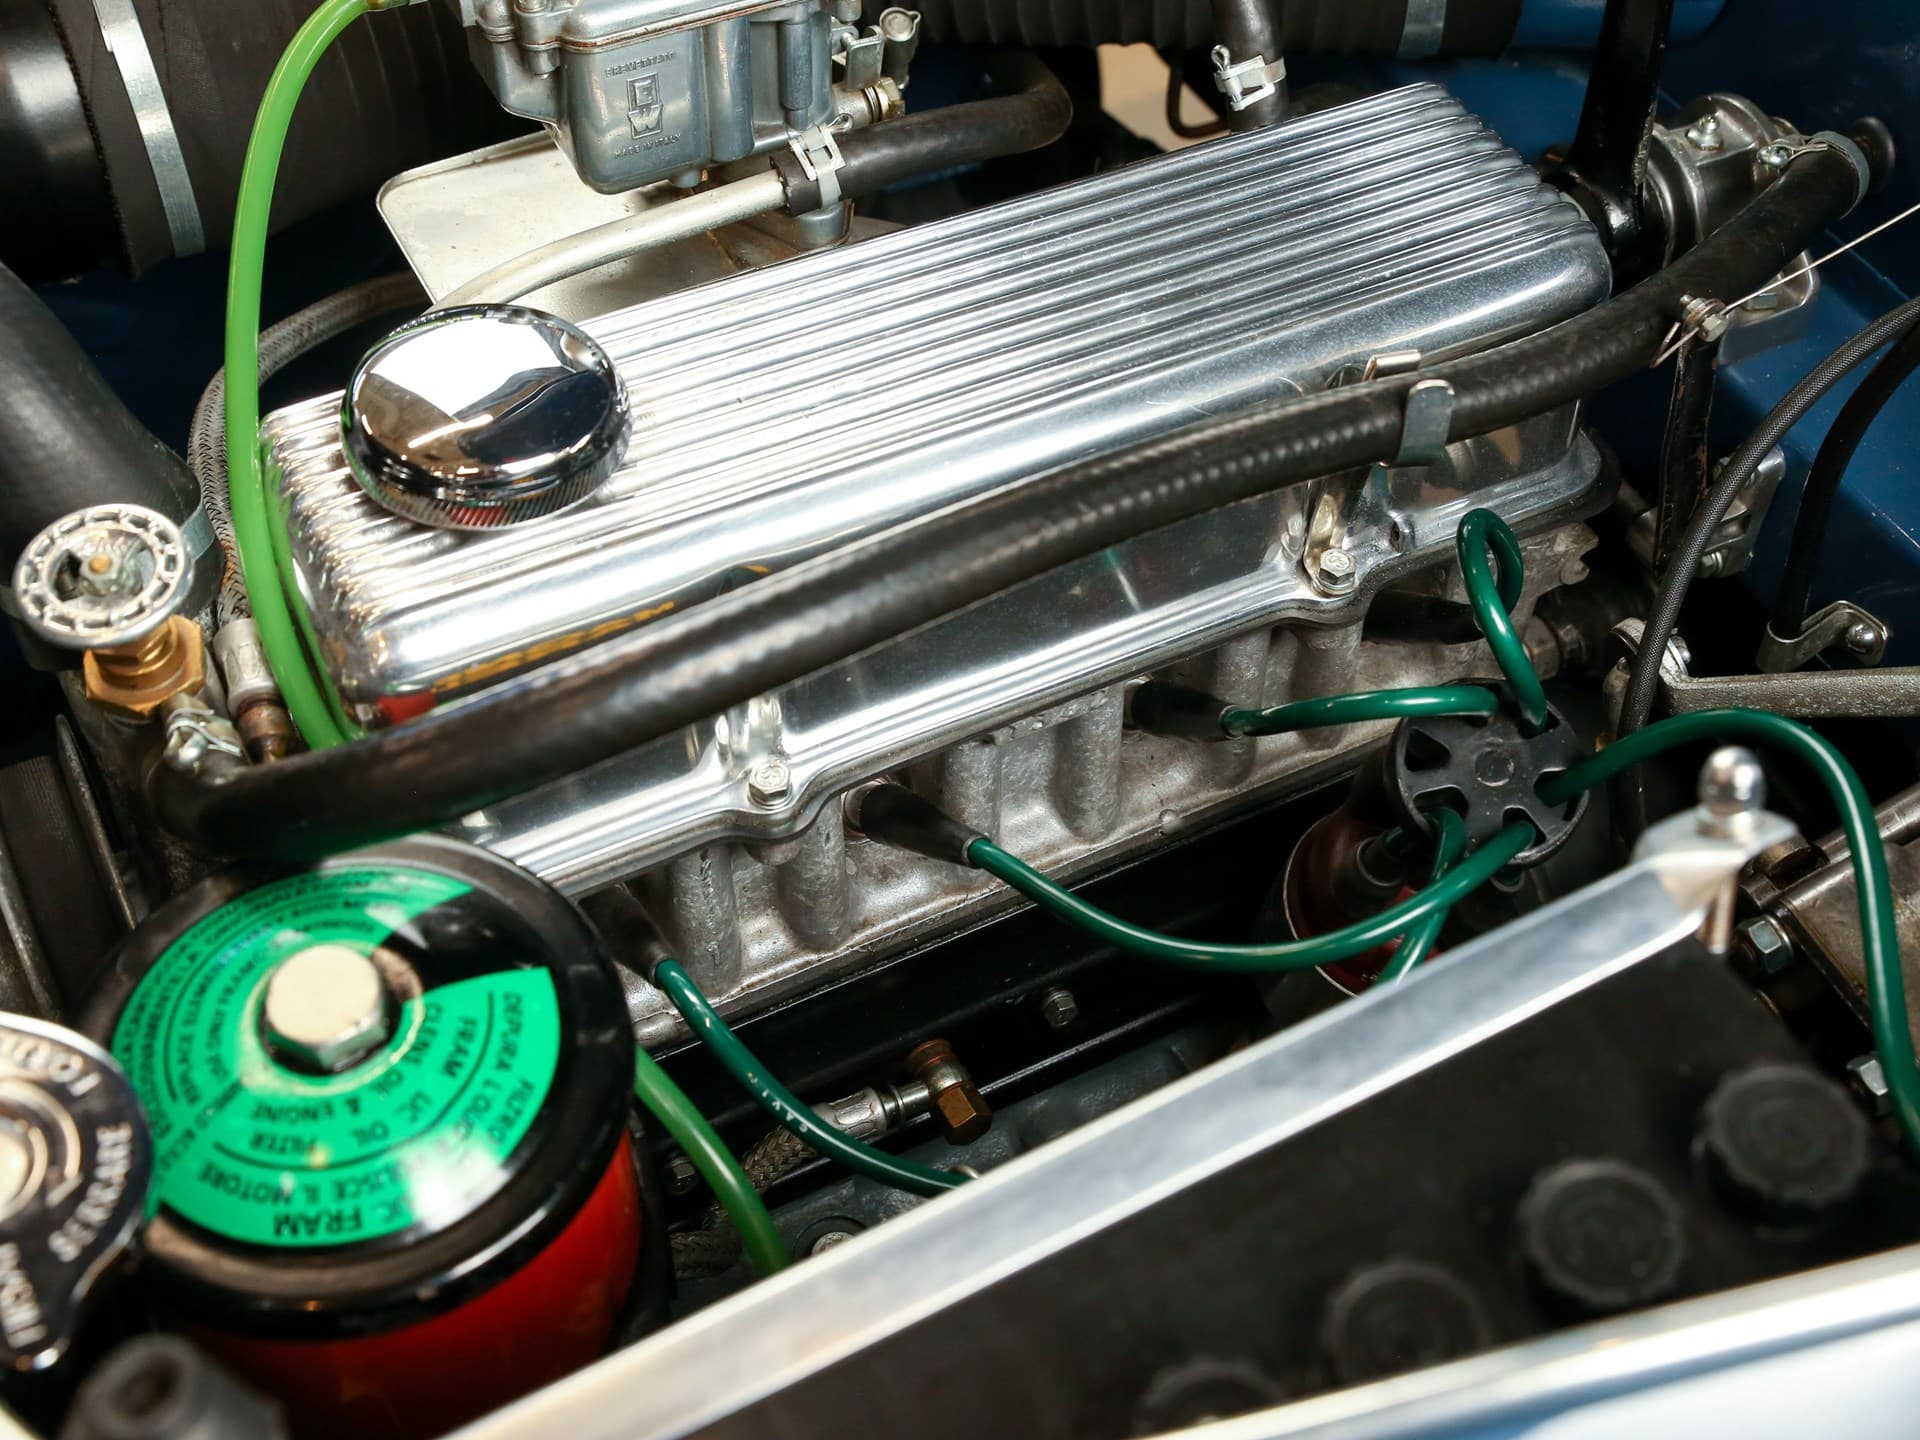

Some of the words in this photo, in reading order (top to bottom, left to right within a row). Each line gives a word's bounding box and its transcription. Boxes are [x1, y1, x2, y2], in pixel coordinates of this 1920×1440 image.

[442, 1016, 478, 1078] FRAM
[495, 991, 523, 1073] DEPURA
[252, 1102, 335, 1126] ENGINE
[485, 1080, 536, 1142] FILTRO
[250, 1131, 317, 1156] FILTER
[352, 1120, 390, 1147] OIL
[197, 1162, 294, 1207] MOTORE
[272, 1210, 363, 1237] FRAM
